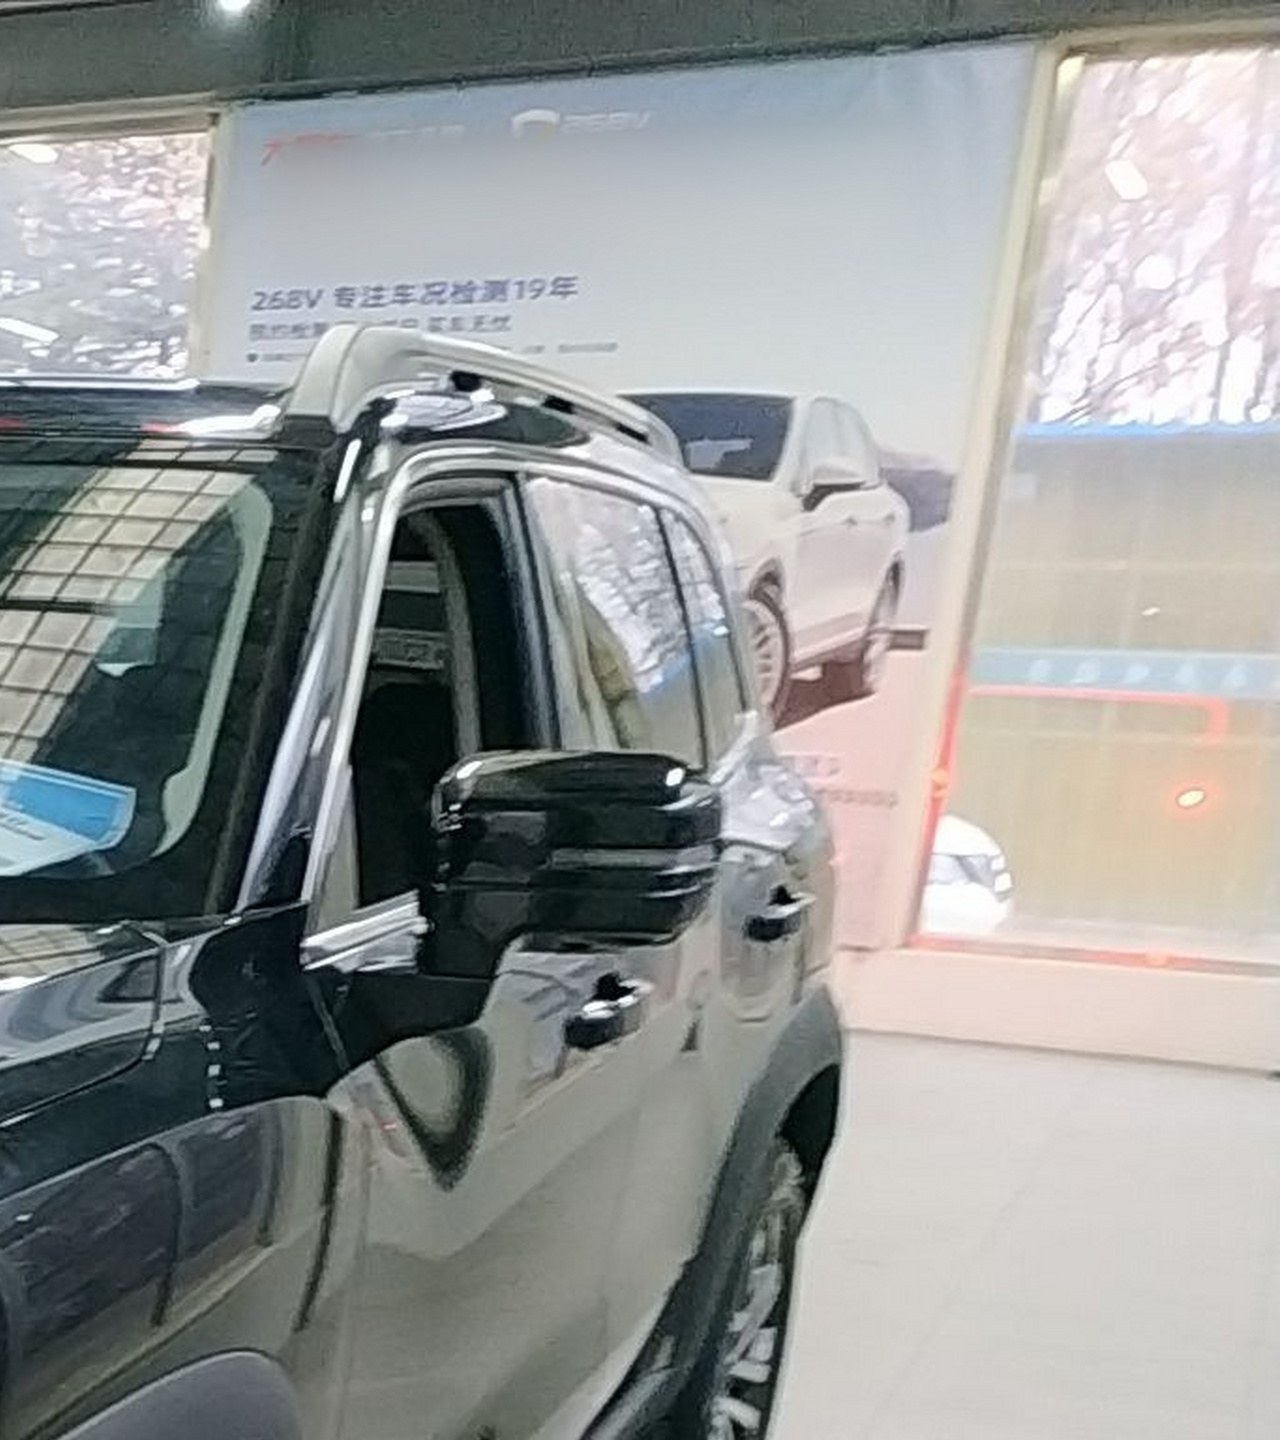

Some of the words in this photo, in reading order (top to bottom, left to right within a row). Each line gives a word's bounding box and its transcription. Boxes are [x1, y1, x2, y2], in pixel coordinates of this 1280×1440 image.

[250, 288, 324, 312] 268V
[334, 275, 580, 310] 专注车况检测19年
